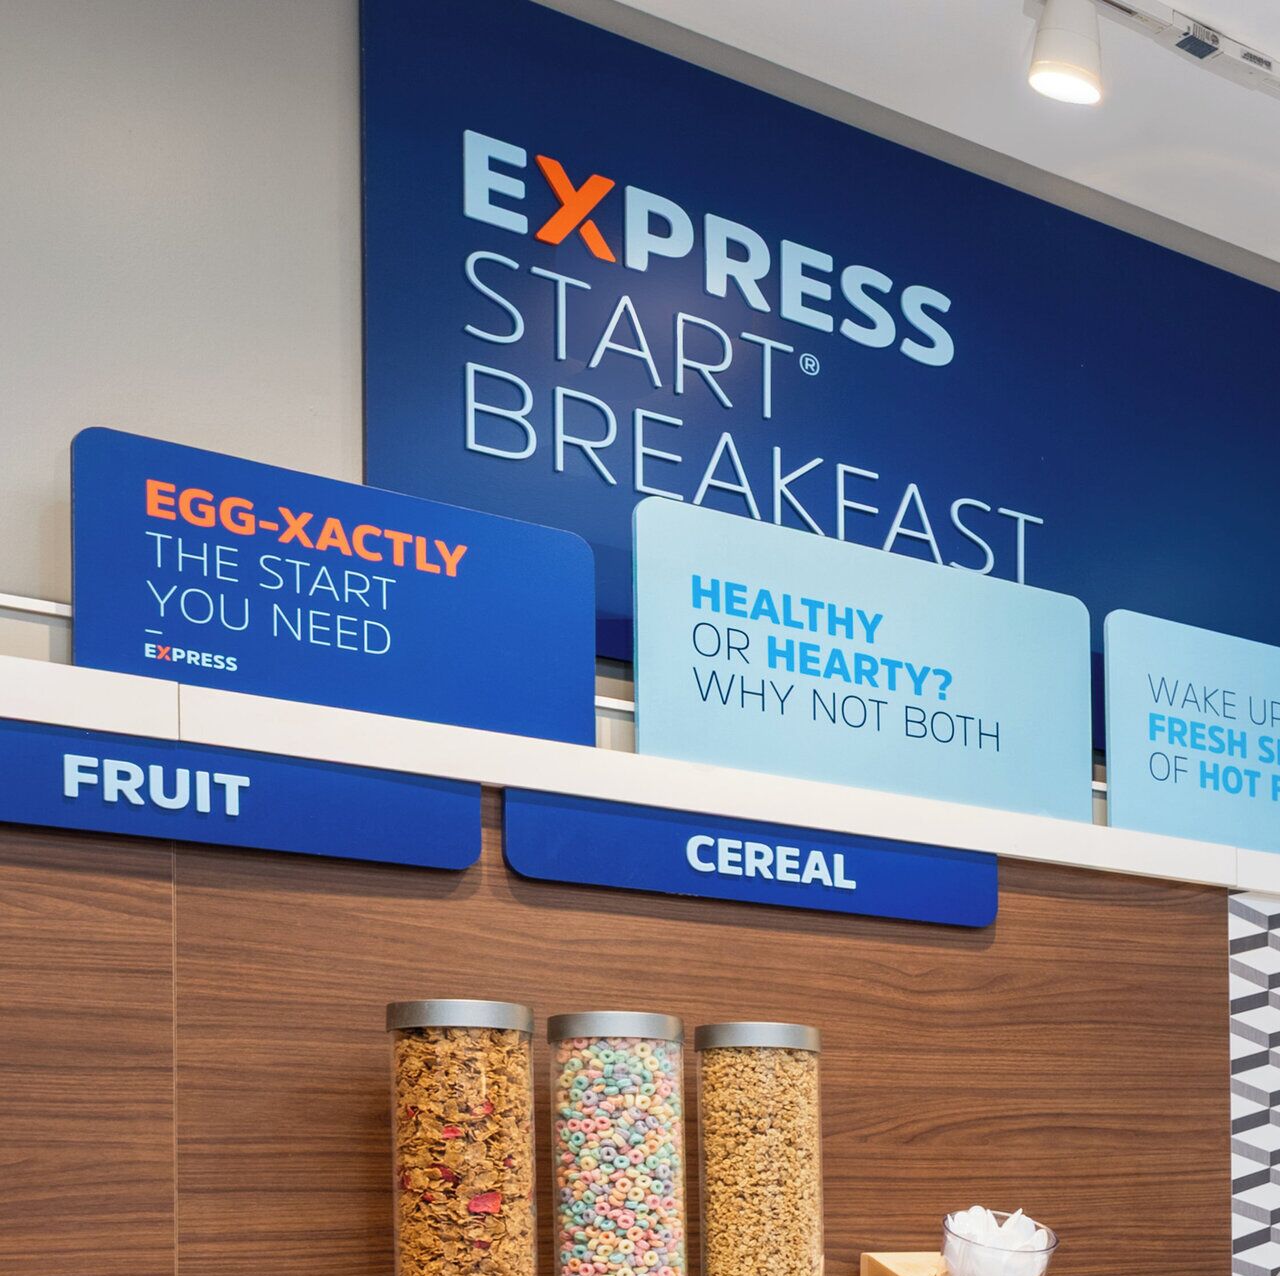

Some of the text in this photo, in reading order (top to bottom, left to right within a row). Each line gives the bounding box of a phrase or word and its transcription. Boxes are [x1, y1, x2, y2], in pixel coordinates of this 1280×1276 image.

[463, 128, 955, 368] EXPRESS
[465, 361, 1044, 585] BREAKFAST
[146, 478, 468, 578] EGG-XACTLY
[145, 530, 396, 610] THE START
[146, 580, 391, 655] YOU NEED
[692, 574, 883, 644] HEALTHY
[144, 642, 238, 672] EXPRESS
[692, 622, 953, 701] OR HEARTY?
[693, 666, 1000, 752] WHY NOT BOTH
[1148, 673, 1237, 720] WAKE
[1148, 712, 1247, 759] FRESH
[62, 752, 250, 817] FRUIT
[1149, 752, 1188, 784] OF
[1199, 761, 1261, 798] HOT
[685, 833, 857, 890] CEREAL
